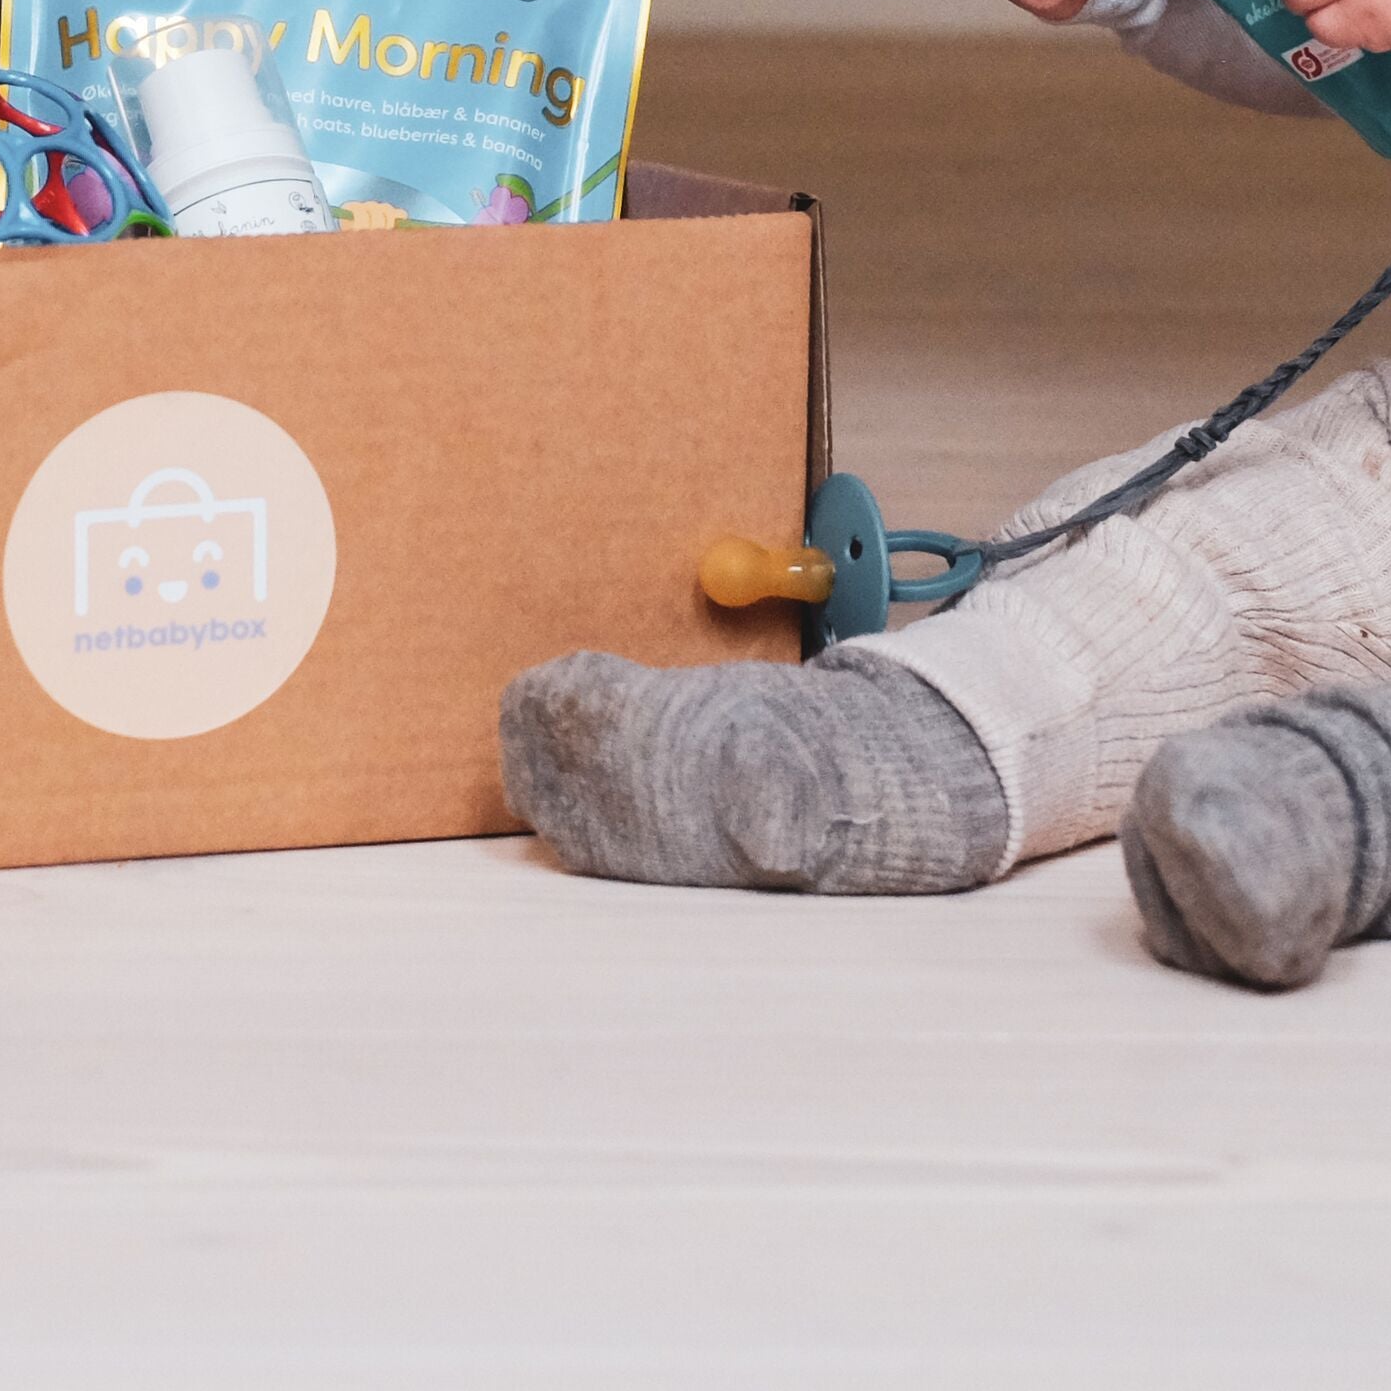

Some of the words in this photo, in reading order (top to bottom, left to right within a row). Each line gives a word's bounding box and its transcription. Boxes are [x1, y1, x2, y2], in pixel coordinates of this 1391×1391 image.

[306, 7, 586, 128] Morning
[321, 90, 376, 114] havre,
[381, 99, 449, 120] blåbær
[453, 106, 468, 122] &
[474, 108, 546, 143] bananer
[313, 118, 356, 137] oats,
[360, 124, 458, 146] blueberries
[462, 133, 477, 148] &
[482, 137, 544, 172] banana
[73, 616, 268, 654] netbabybox
